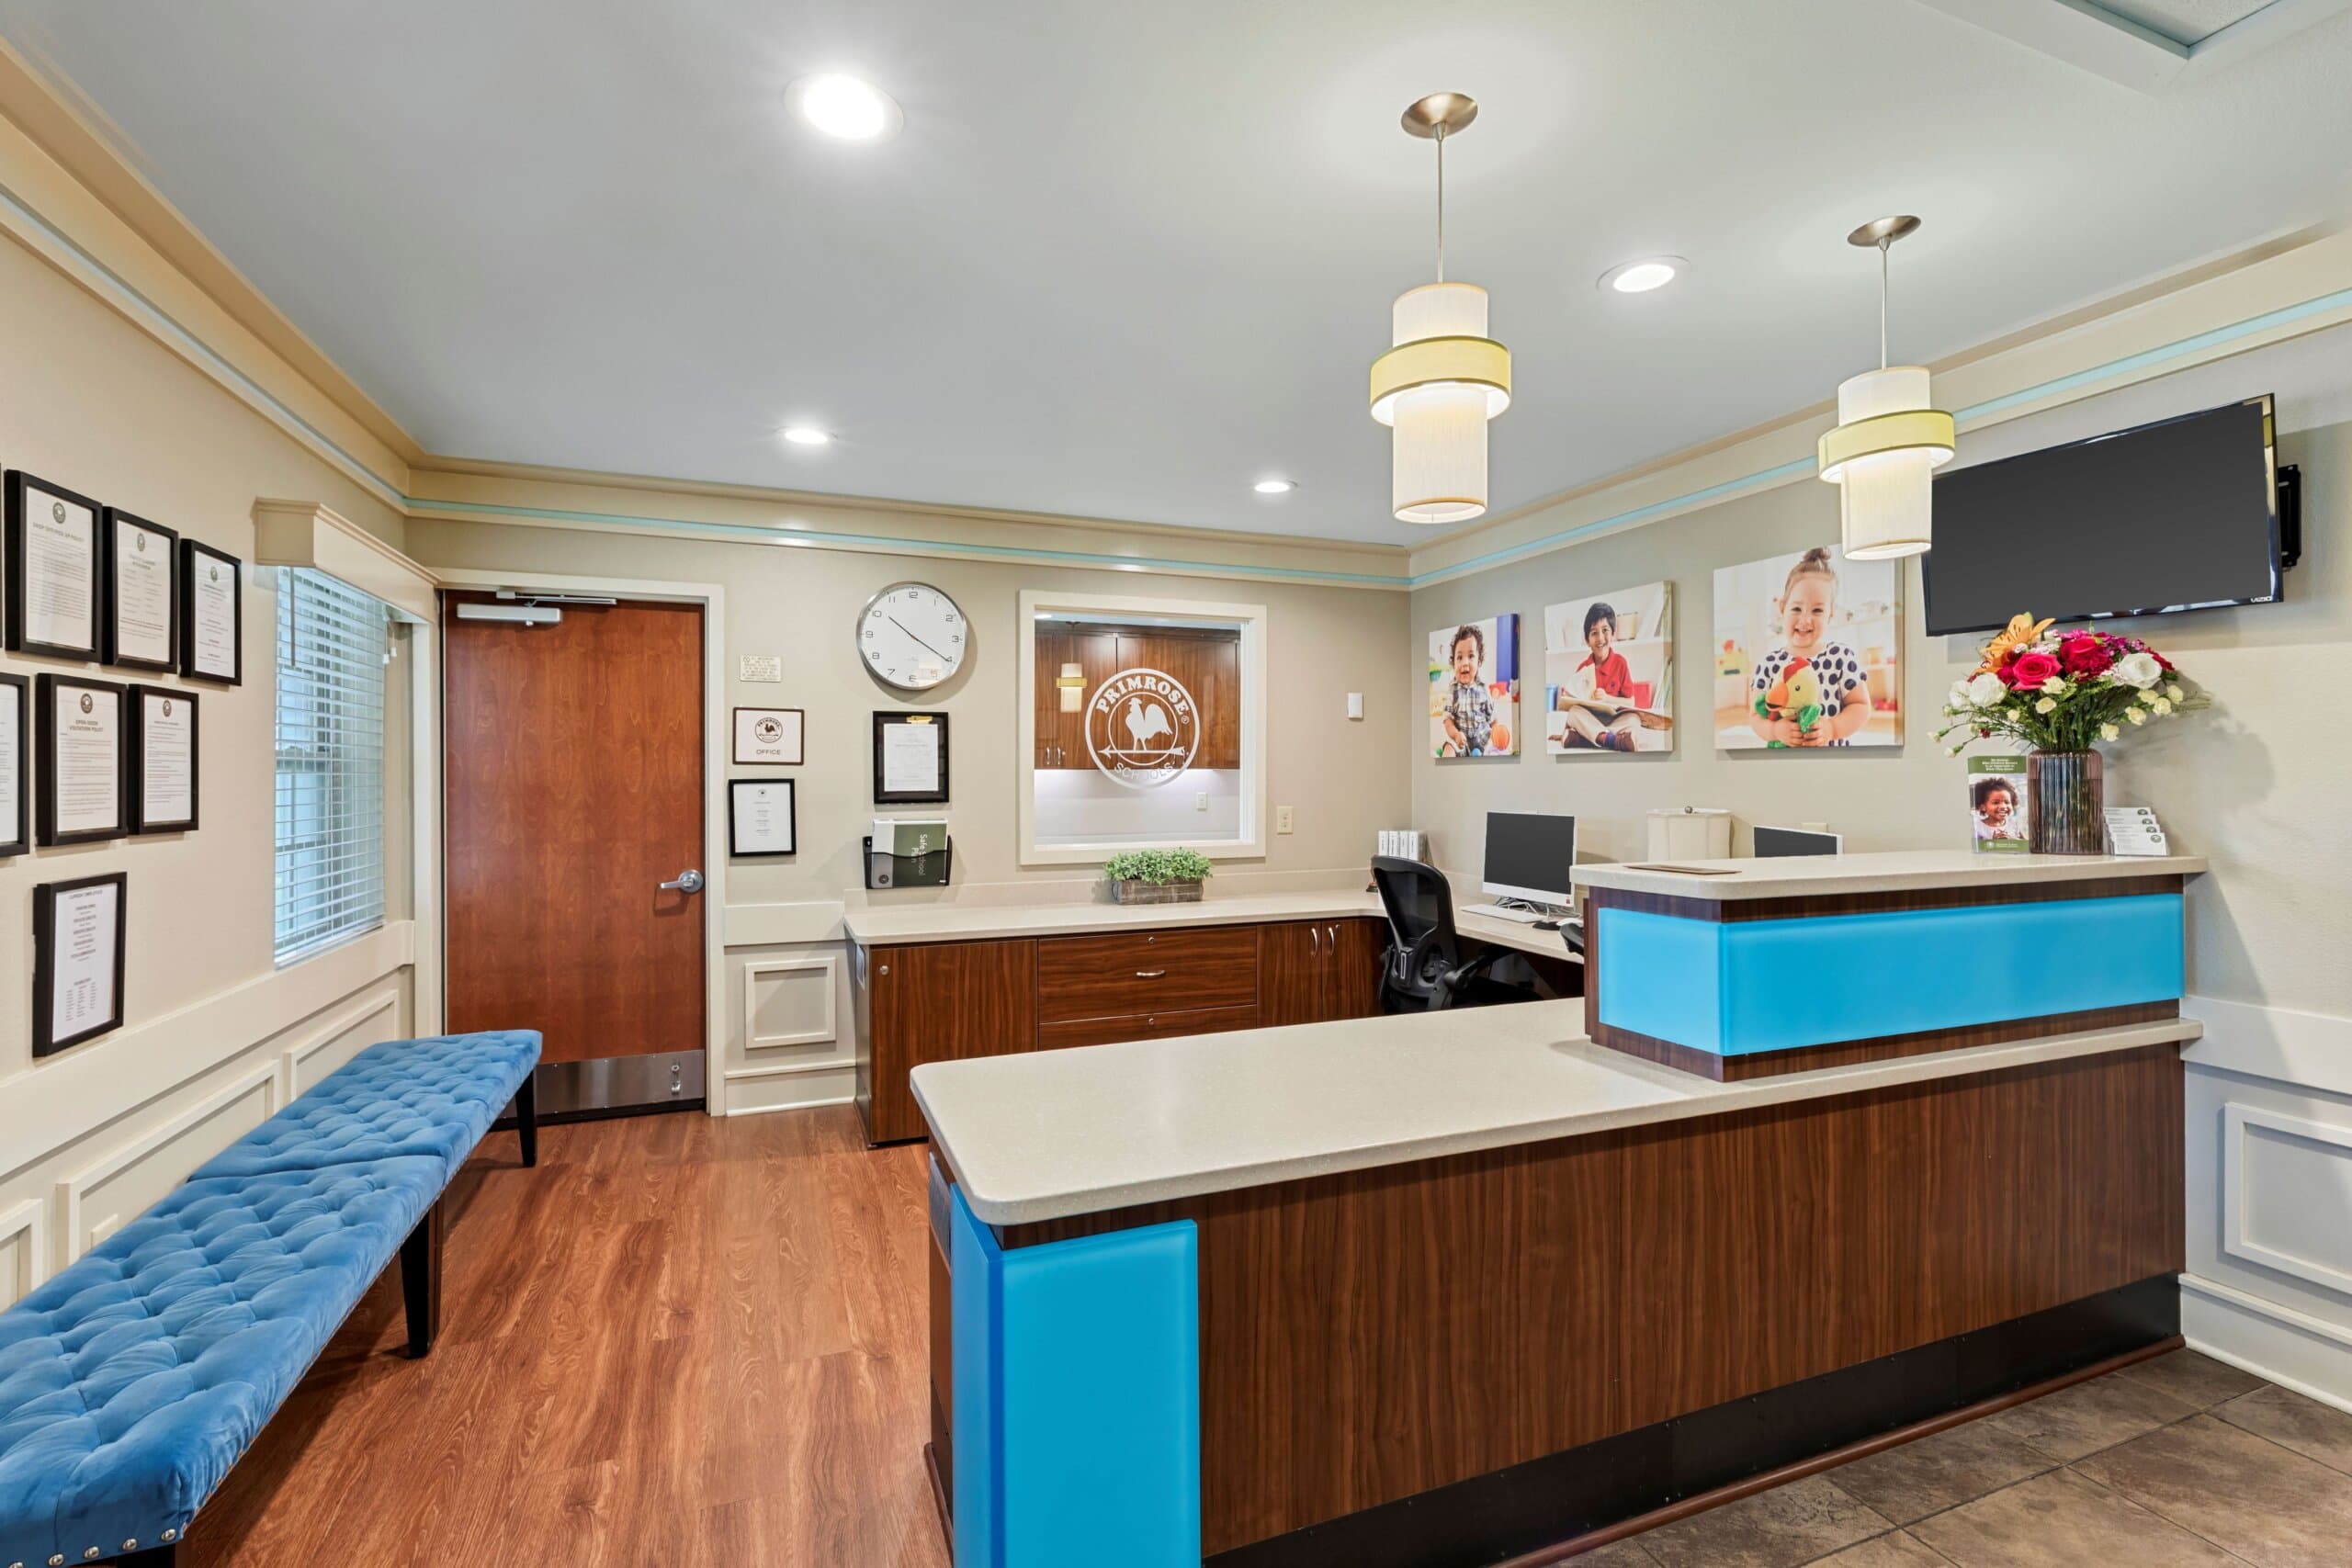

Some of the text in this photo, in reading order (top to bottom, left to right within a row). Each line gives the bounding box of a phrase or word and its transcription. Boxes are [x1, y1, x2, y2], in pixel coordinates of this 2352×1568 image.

[872, 610, 882, 618] 10
[1096, 676, 1189, 715] PRIMROSE
[1114, 762, 1173, 779] SCHOLS
[919, 833, 928, 850] Safe
